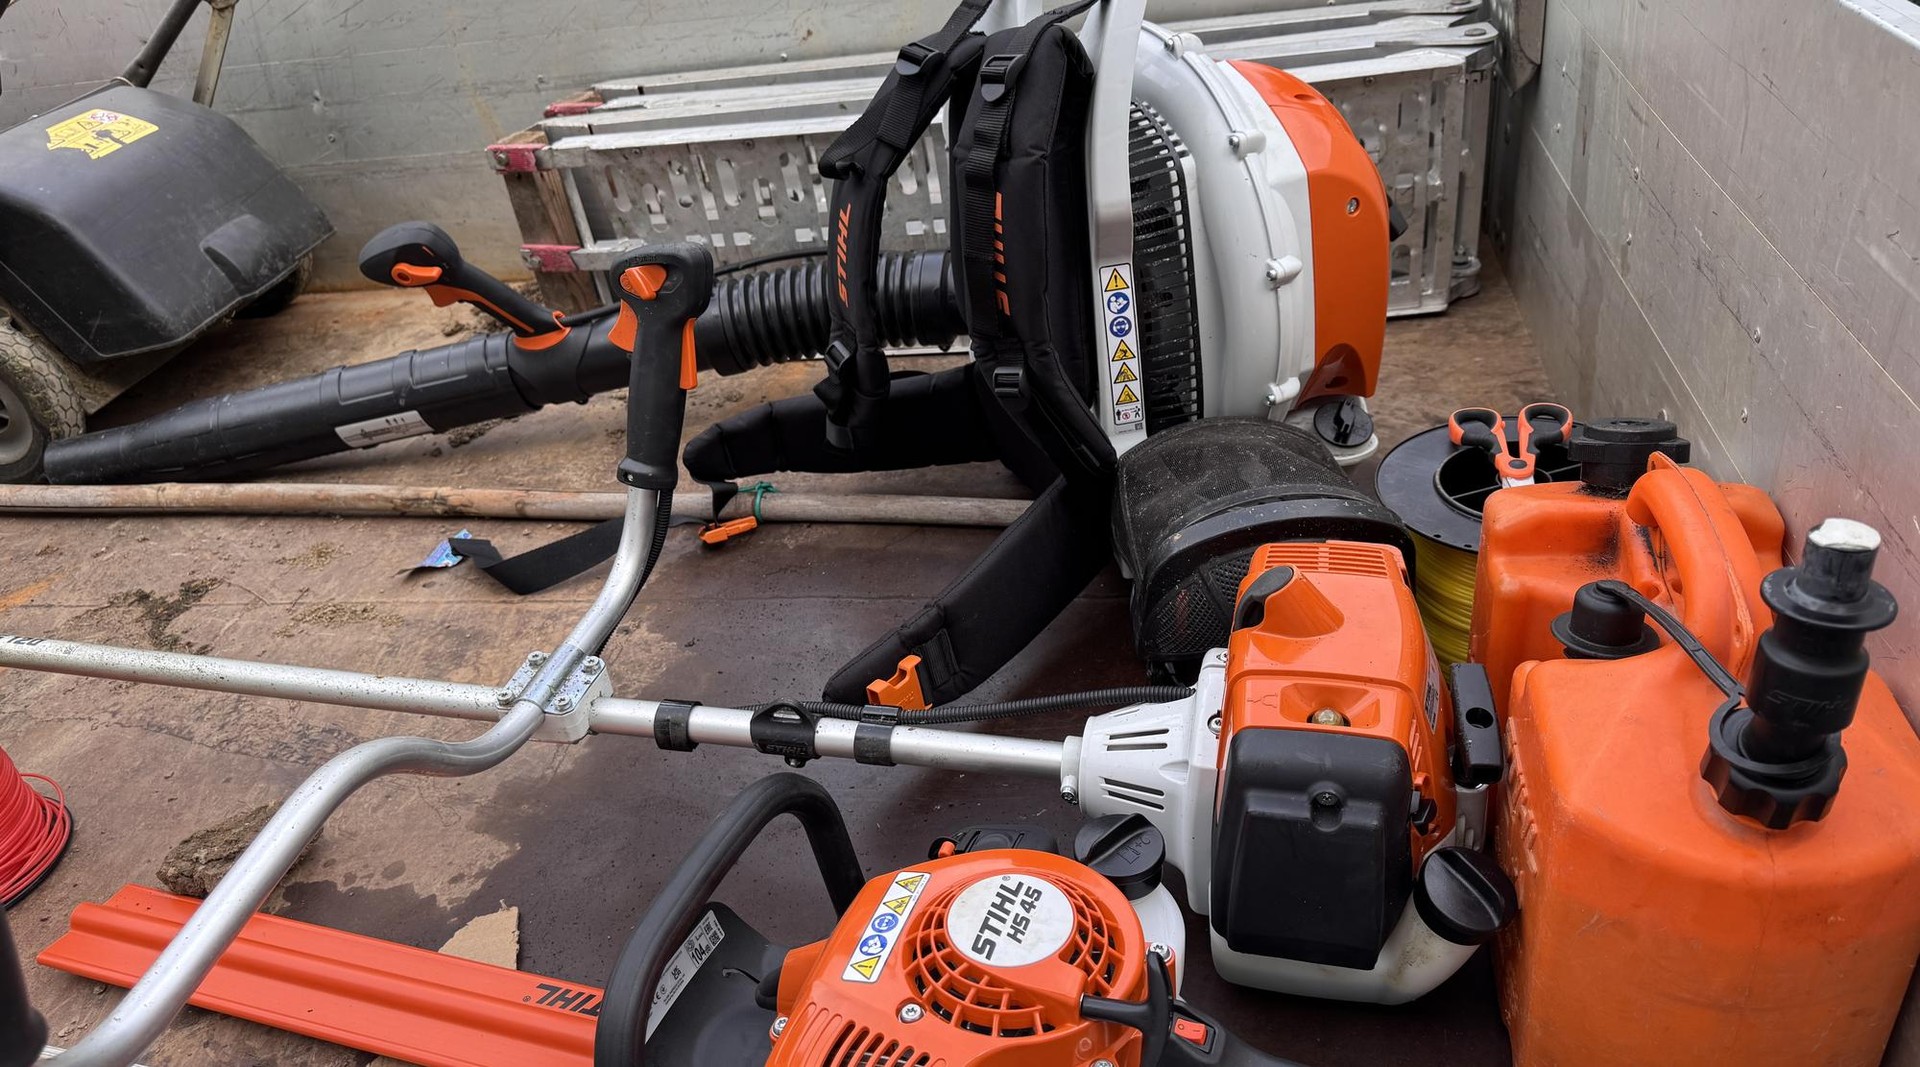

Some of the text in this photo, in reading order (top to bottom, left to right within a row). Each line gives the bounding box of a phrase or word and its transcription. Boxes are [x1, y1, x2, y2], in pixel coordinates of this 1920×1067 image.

[837, 203, 851, 308] STIHL
[971, 881, 1024, 961] STIHL
[1006, 886, 1043, 945] HS 45
[691, 943, 706, 965] 104
